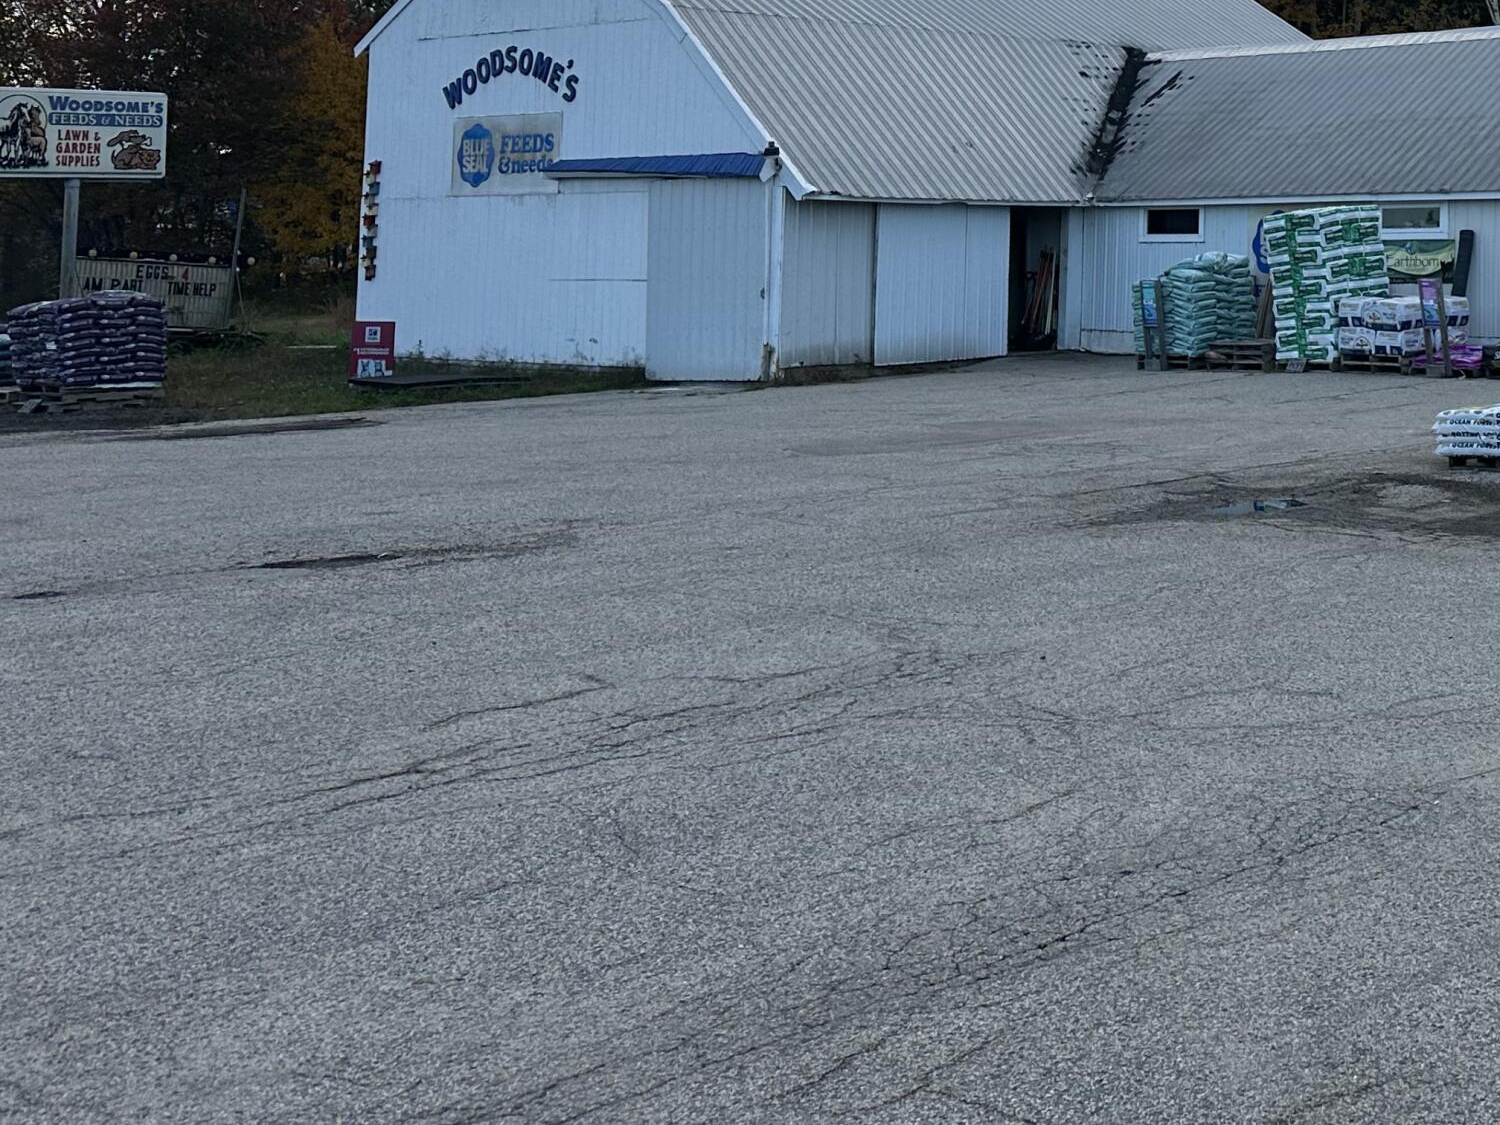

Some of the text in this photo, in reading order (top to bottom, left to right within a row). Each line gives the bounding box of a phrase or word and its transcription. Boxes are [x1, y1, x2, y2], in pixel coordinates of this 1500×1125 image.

[442, 45, 579, 109] WOODSOME'S
[48, 96, 163, 113] WOODSOME'S
[52, 114, 161, 126] FEEDS & NEEDS
[57, 129, 101, 141] LAWN &
[56, 142, 101, 154] GARDEN
[462, 139, 490, 155] BLUE
[500, 133, 555, 154] FEEDS
[55, 155, 100, 167] SUPPLIES
[462, 156, 488, 173] SEAL
[136, 265, 169, 280] EGGS
[193, 283, 216, 296] HELP
